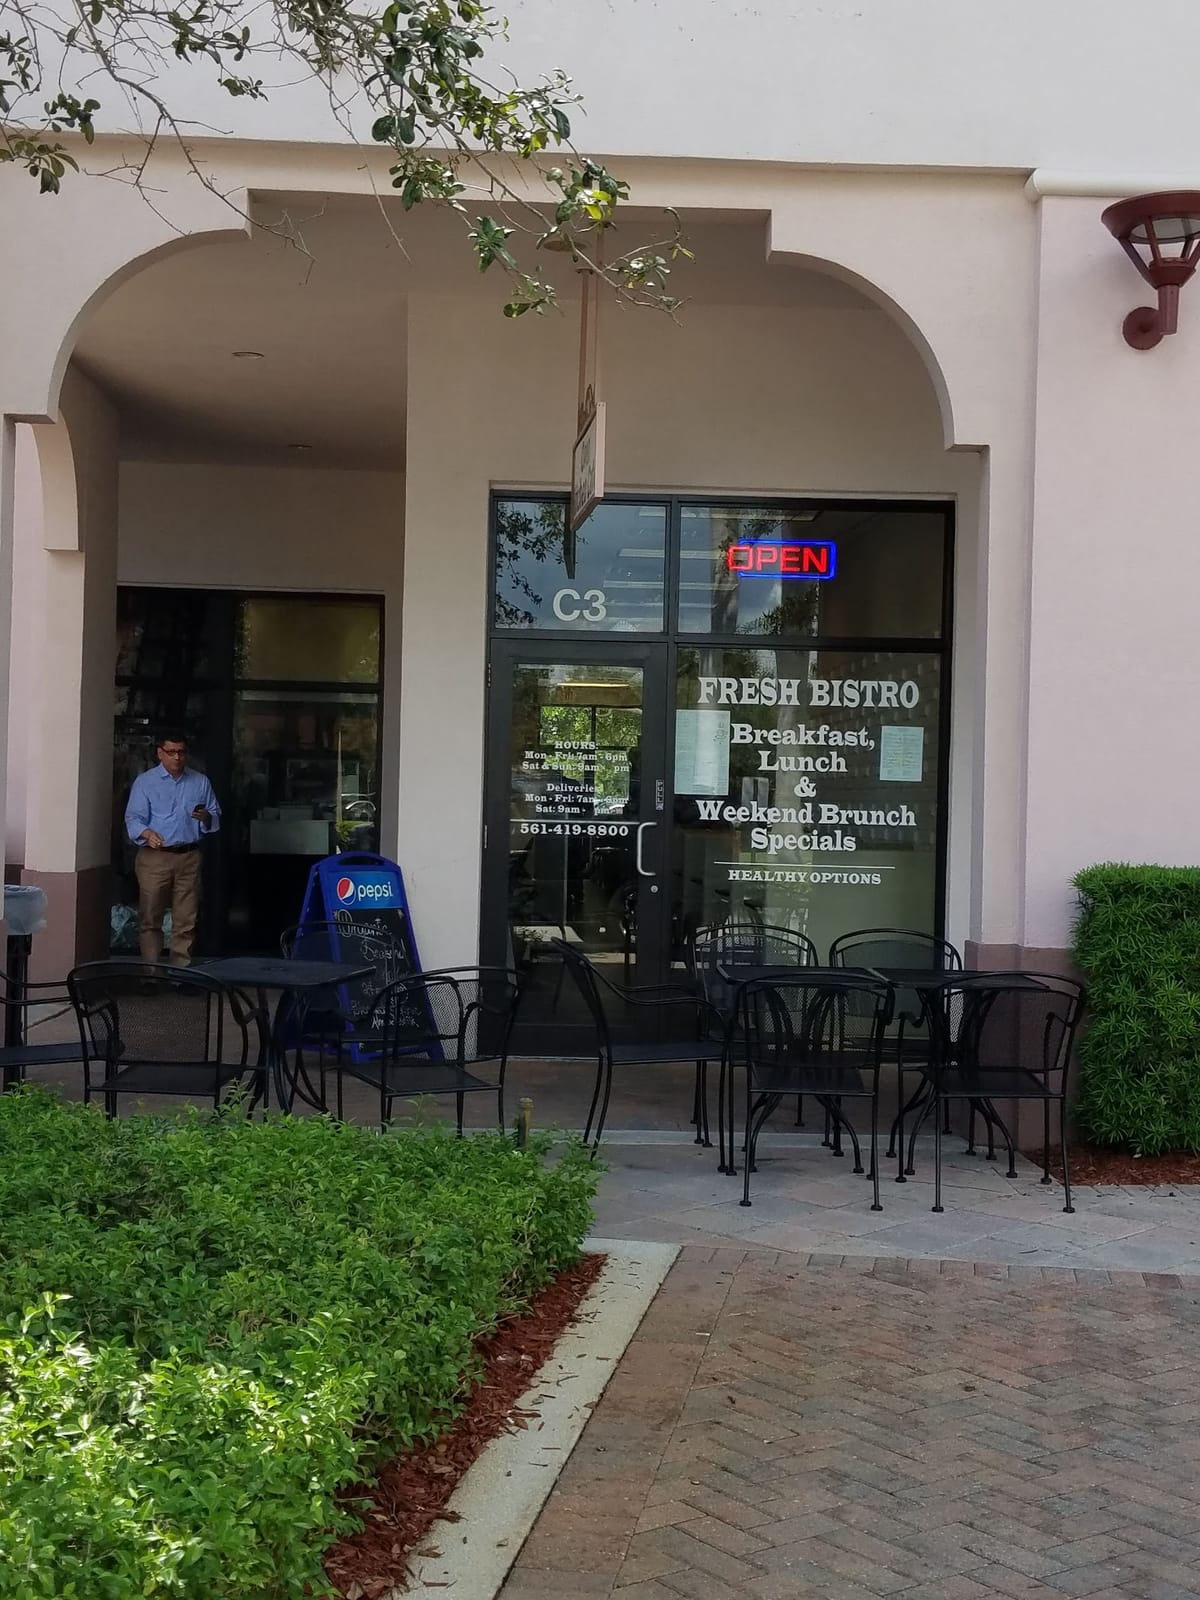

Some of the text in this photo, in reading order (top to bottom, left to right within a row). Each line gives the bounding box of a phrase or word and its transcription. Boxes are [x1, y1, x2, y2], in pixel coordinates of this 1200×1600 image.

[727, 544, 829, 573] OPEN
[552, 588, 608, 621] C3
[697, 677, 920, 708] FRESH BISTRO
[554, 741, 599, 750] HOURS:
[731, 723, 875, 750] Breakfast,
[522, 762, 539, 770] Sat
[524, 751, 547, 760] Mon
[605, 753, 628, 763] 6pm
[758, 751, 848, 772] Lunch
[546, 783, 602, 793] Deliverie
[794, 776, 817, 798] &
[525, 794, 547, 802] Mon
[555, 795, 574, 803] Fri:
[535, 805, 556, 813] Sat:
[558, 805, 580, 814] 9am
[696, 800, 917, 826] Weekend Brunch
[520, 823, 629, 837] 561-419-8800
[750, 828, 857, 855] Specials
[728, 870, 881, 885] HEALTHY OPTIONS
[357, 881, 394, 901] pepsi
